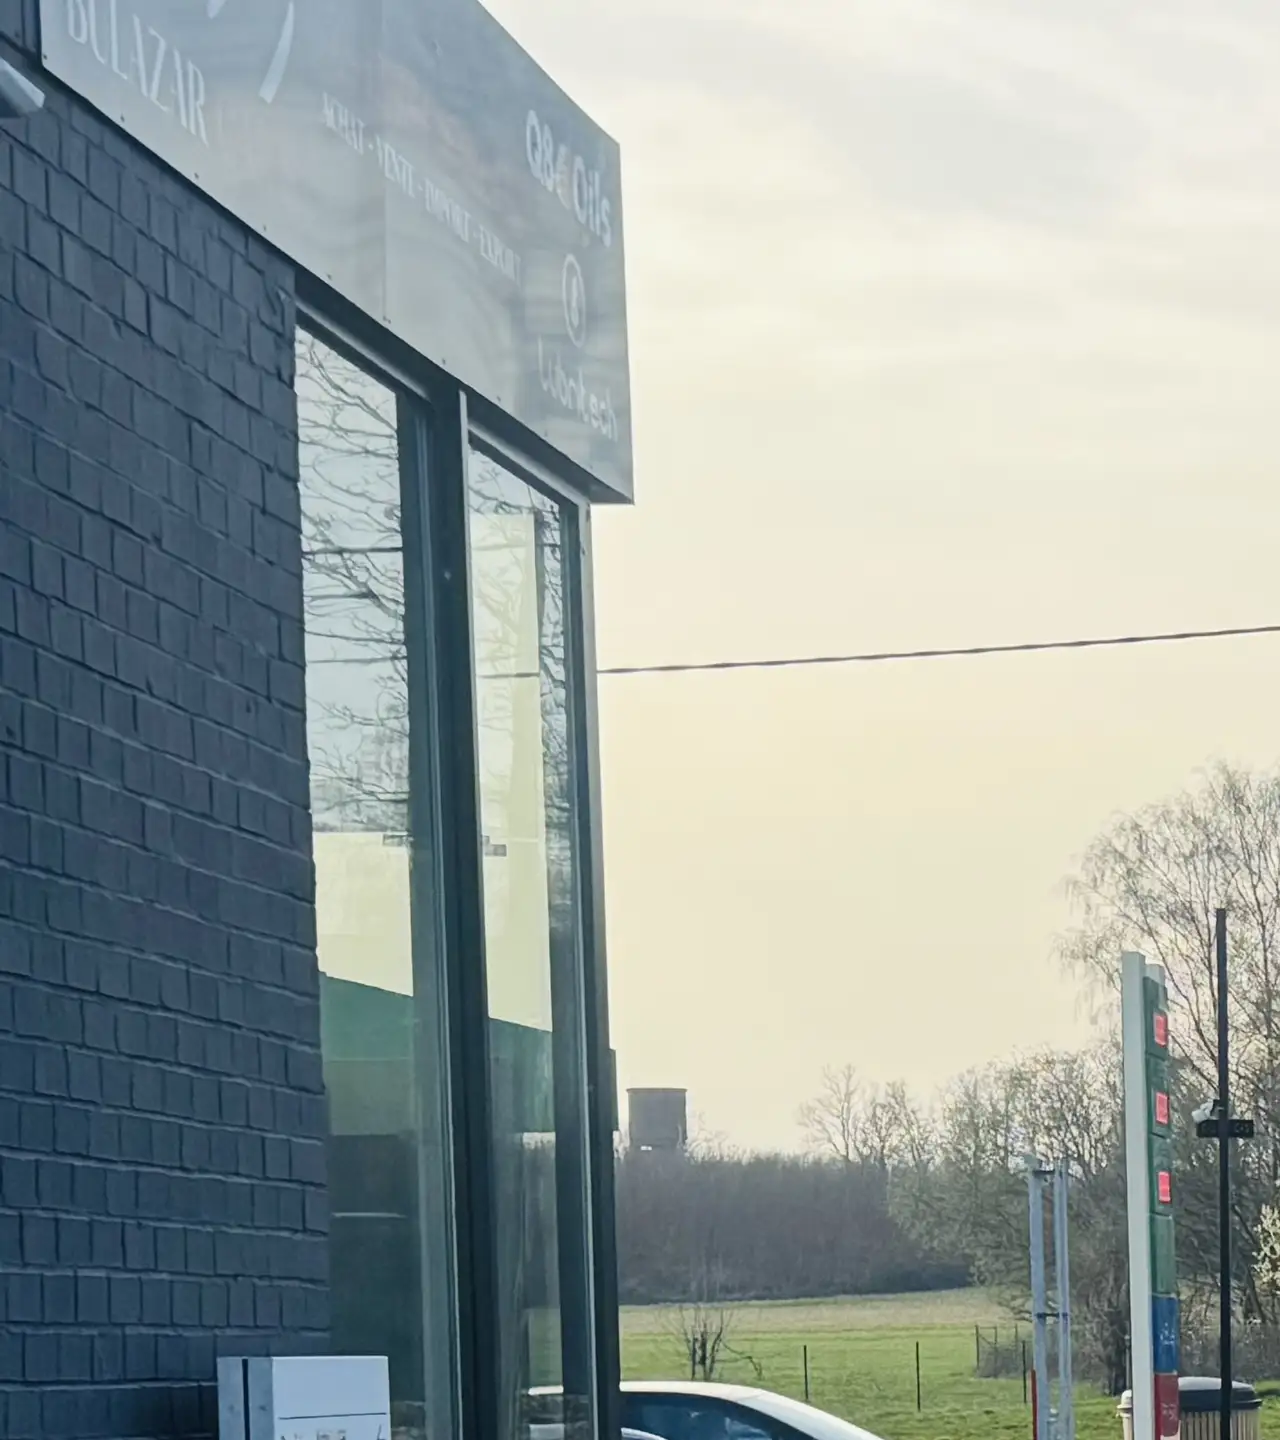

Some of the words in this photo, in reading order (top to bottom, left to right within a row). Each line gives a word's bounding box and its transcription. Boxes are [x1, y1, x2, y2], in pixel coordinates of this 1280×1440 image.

[375, 134, 416, 199] VENTE
[525, 109, 554, 192] Q8
[573, 155, 612, 248] Oils
